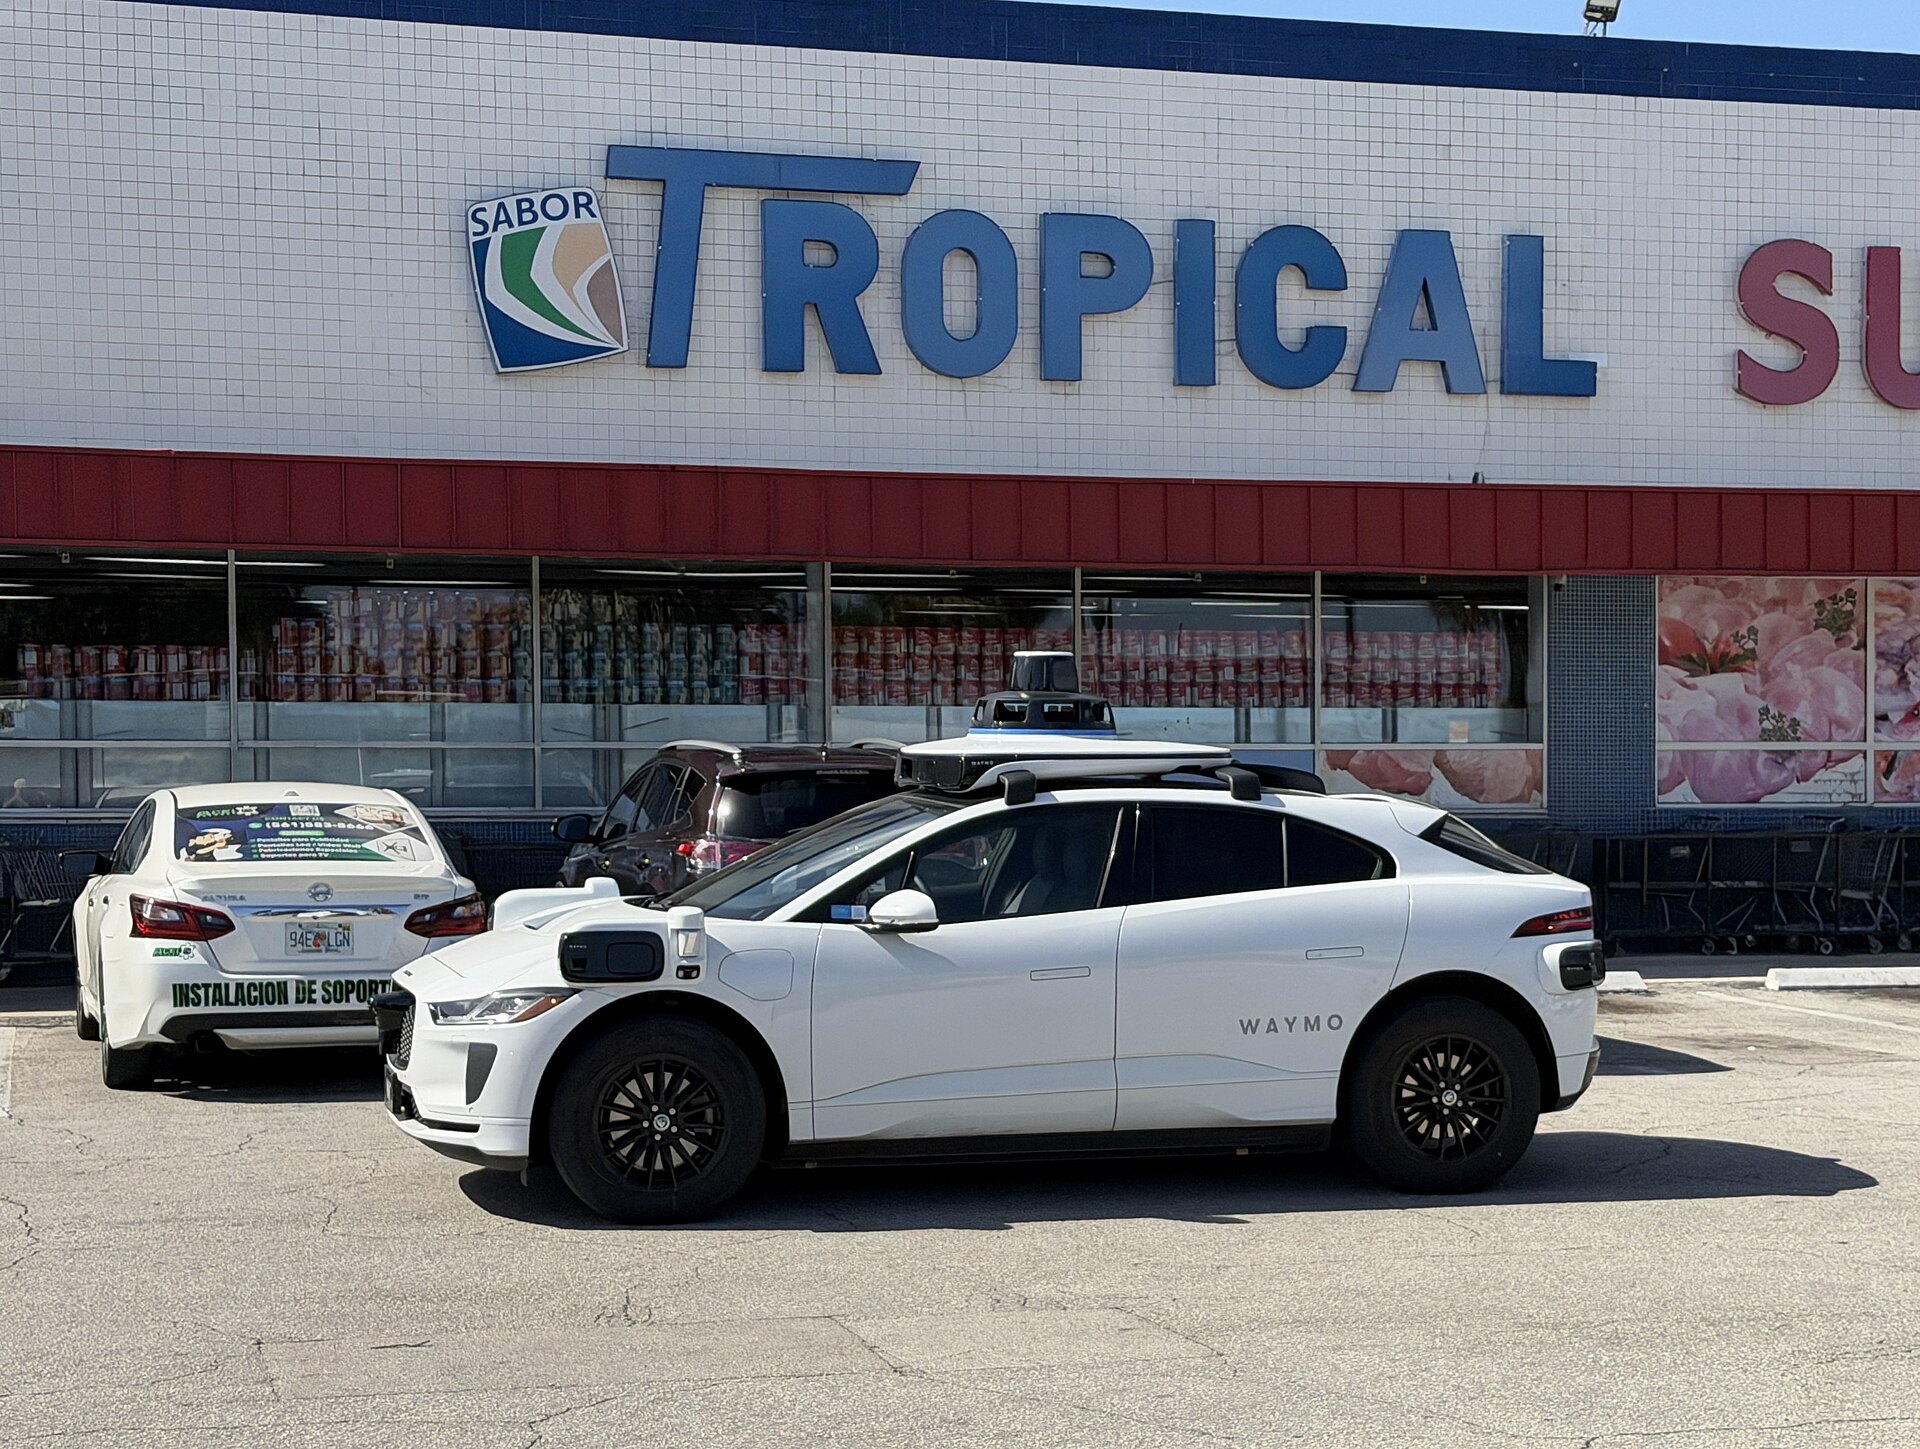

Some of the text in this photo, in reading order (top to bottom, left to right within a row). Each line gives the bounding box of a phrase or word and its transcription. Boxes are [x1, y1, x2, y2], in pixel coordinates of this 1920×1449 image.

[470, 191, 598, 237] SABOR
[606, 144, 1920, 409] TROPICAL SU
[289, 931, 350, 947] 94E LGN
[171, 979, 392, 1008] INSTALACION DE SOPORT
[1238, 1013, 1344, 1035] WAYMO
